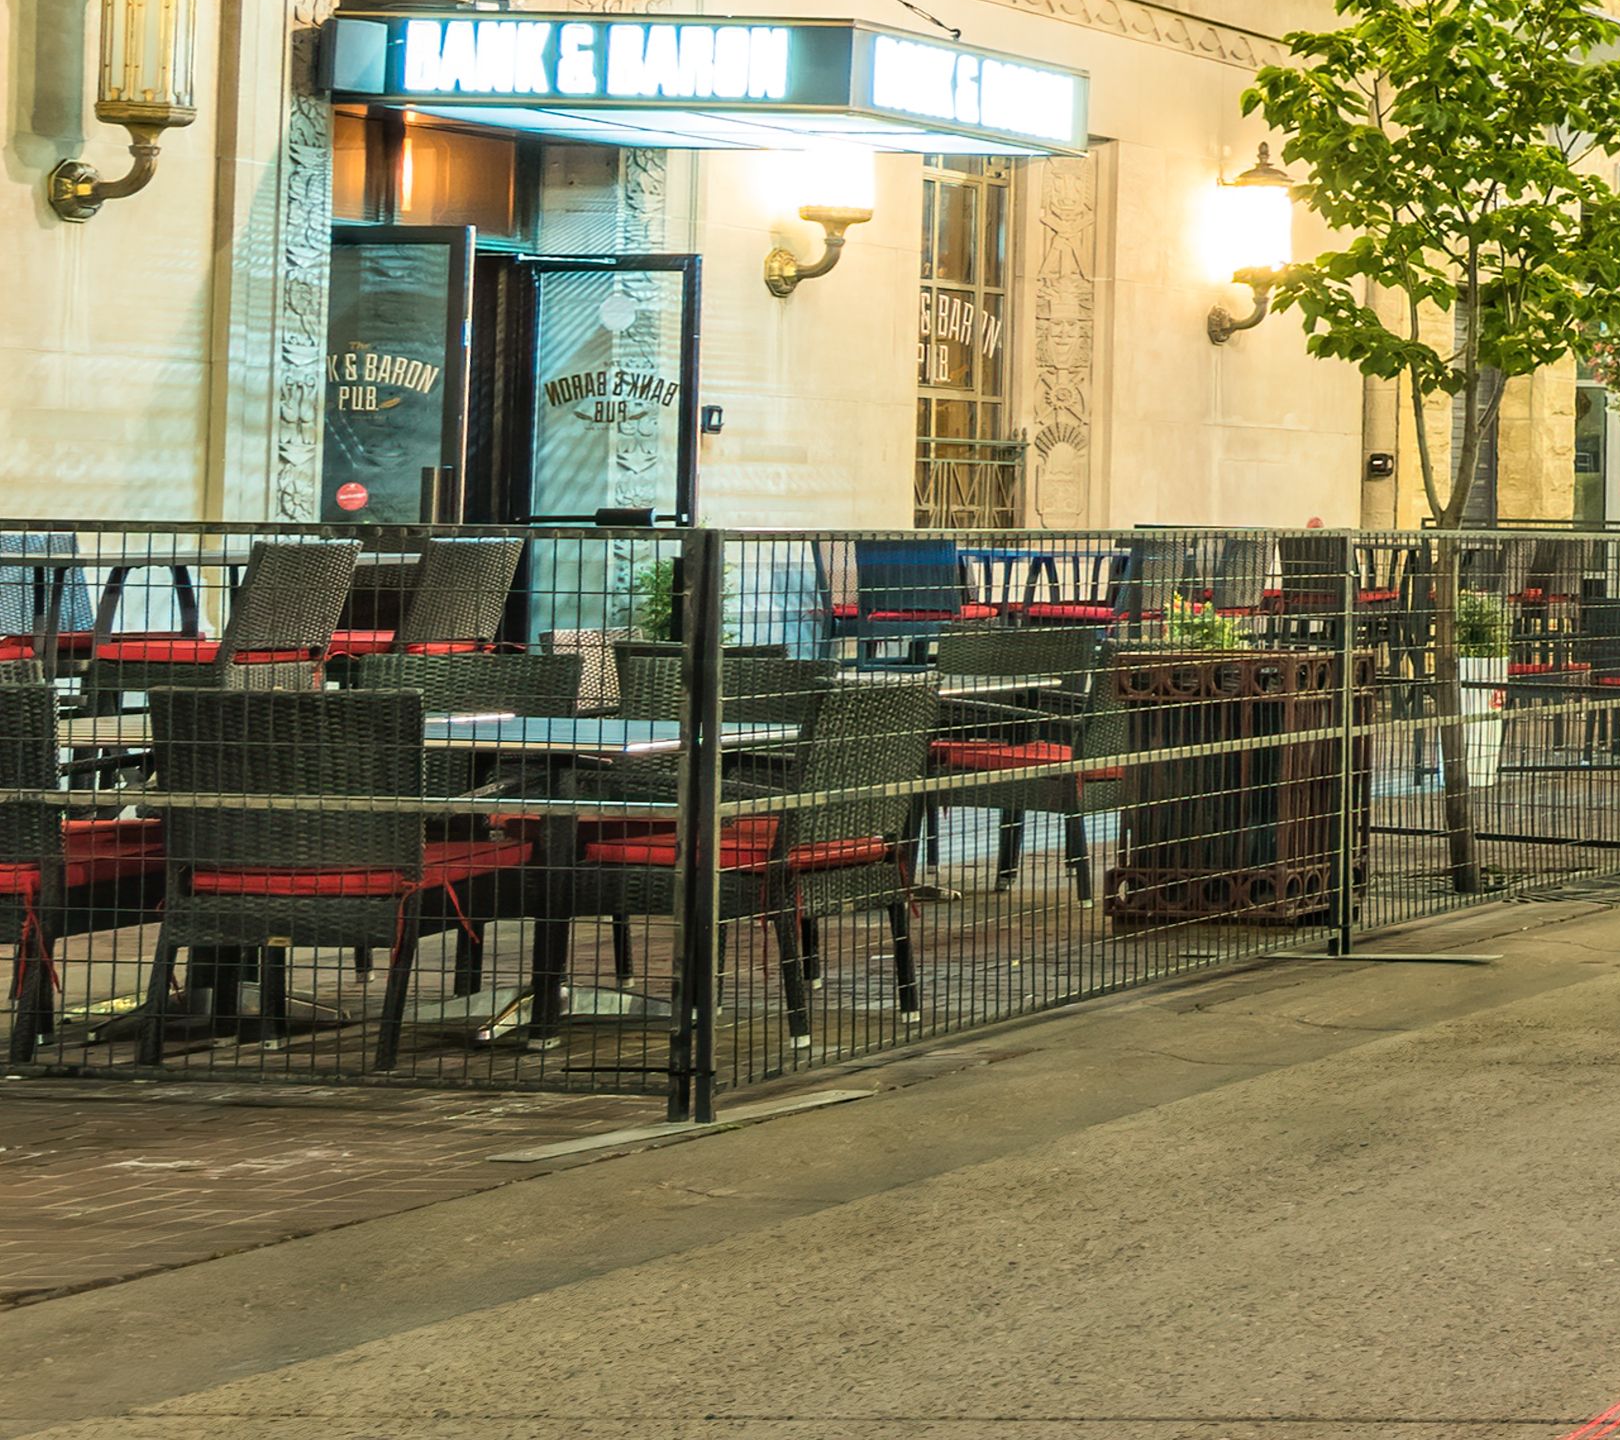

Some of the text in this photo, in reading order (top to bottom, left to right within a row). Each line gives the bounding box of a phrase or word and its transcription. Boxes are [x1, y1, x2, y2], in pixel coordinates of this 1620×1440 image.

[556, 21, 597, 95] &
[344, 352, 358, 382] &
[364, 353, 440, 394] BARON
